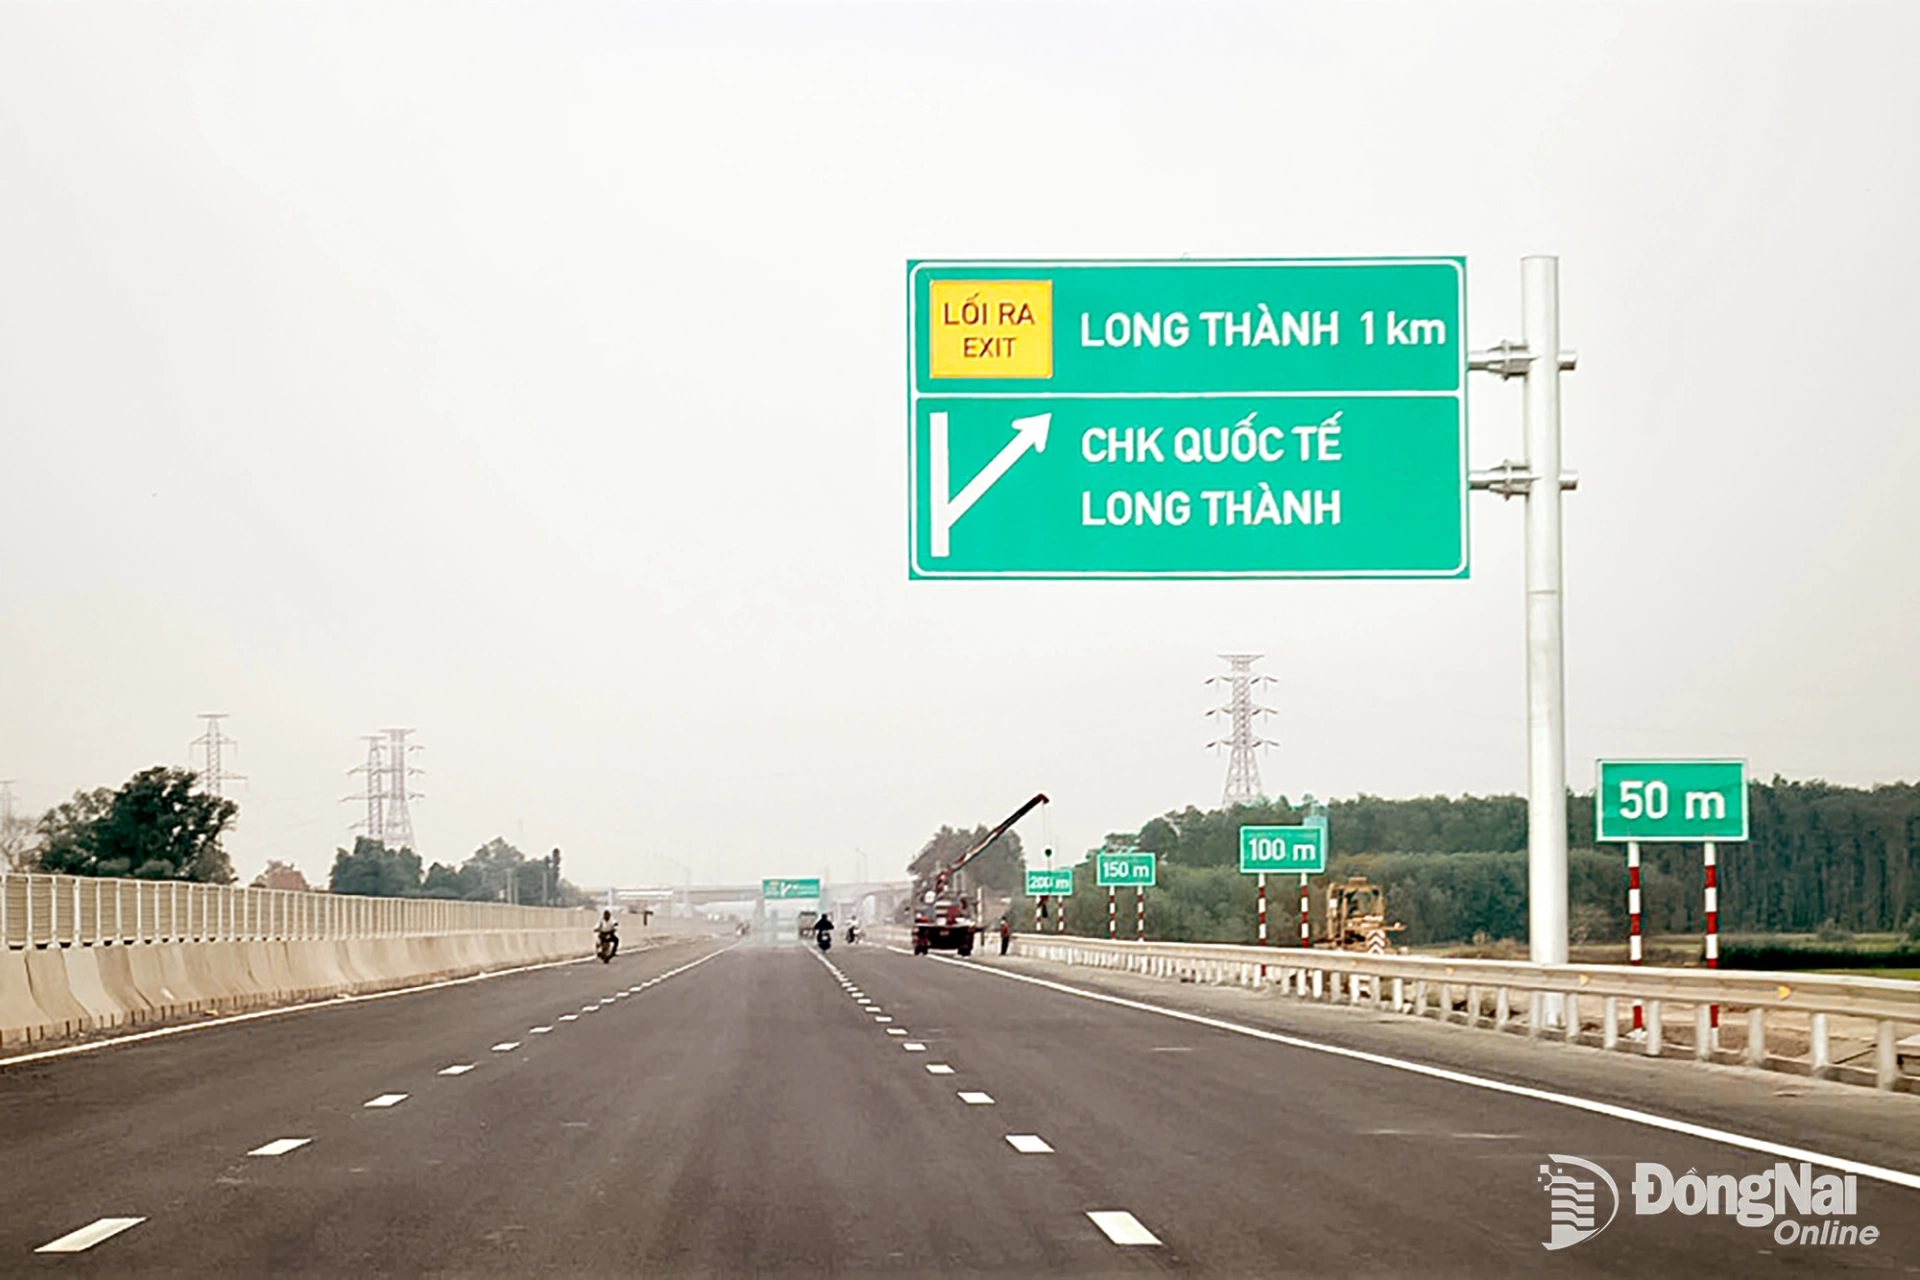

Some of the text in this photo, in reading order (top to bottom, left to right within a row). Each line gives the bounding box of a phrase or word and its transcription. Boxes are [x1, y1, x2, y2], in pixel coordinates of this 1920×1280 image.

[944, 293, 1035, 325] LỐI RA
[1081, 303, 1446, 347] LONG THÀNH 1 km
[963, 337, 1016, 358] EXIT
[1081, 411, 1343, 463] CHK QUỐC TẾ
[1082, 482, 1341, 526] LONG THÀNH
[1619, 780, 1726, 820] 50 m
[1248, 837, 1316, 861] 100 m
[1103, 860, 1150, 878] 150 m
